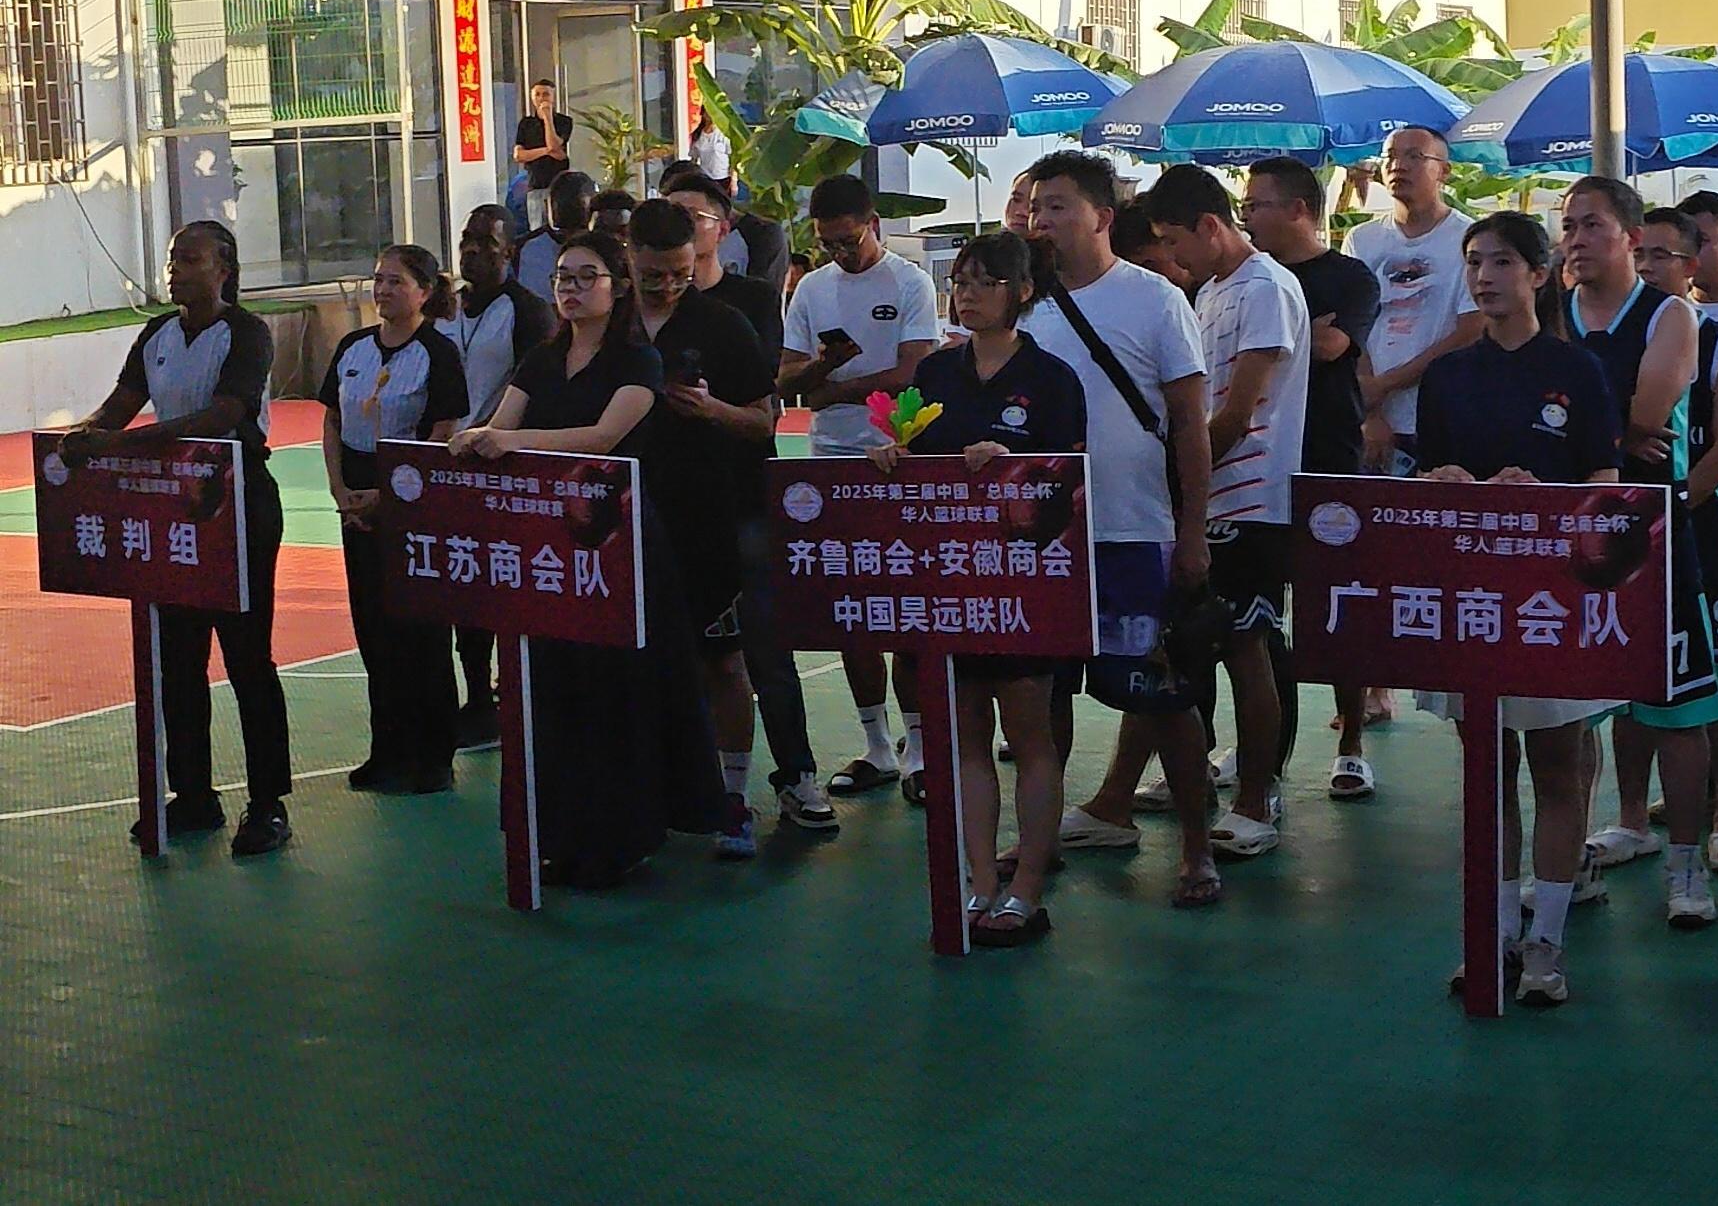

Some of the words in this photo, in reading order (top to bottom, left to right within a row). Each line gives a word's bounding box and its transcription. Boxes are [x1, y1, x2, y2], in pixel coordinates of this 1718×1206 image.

[1032, 92, 1091, 104] JOMOO
[1205, 102, 1287, 113] JOMOO
[904, 114, 975, 132] JOMOO
[901, 505, 999, 523] 华人篮球联赛
[75, 513, 199, 566] 裁判组
[1453, 535, 1572, 559] 华人篮球联赛
[405, 530, 610, 599] 江苏商会队
[787, 538, 1072, 577] 齐鲁商会+安徽商会
[1325, 580, 1631, 648] 广西商会队
